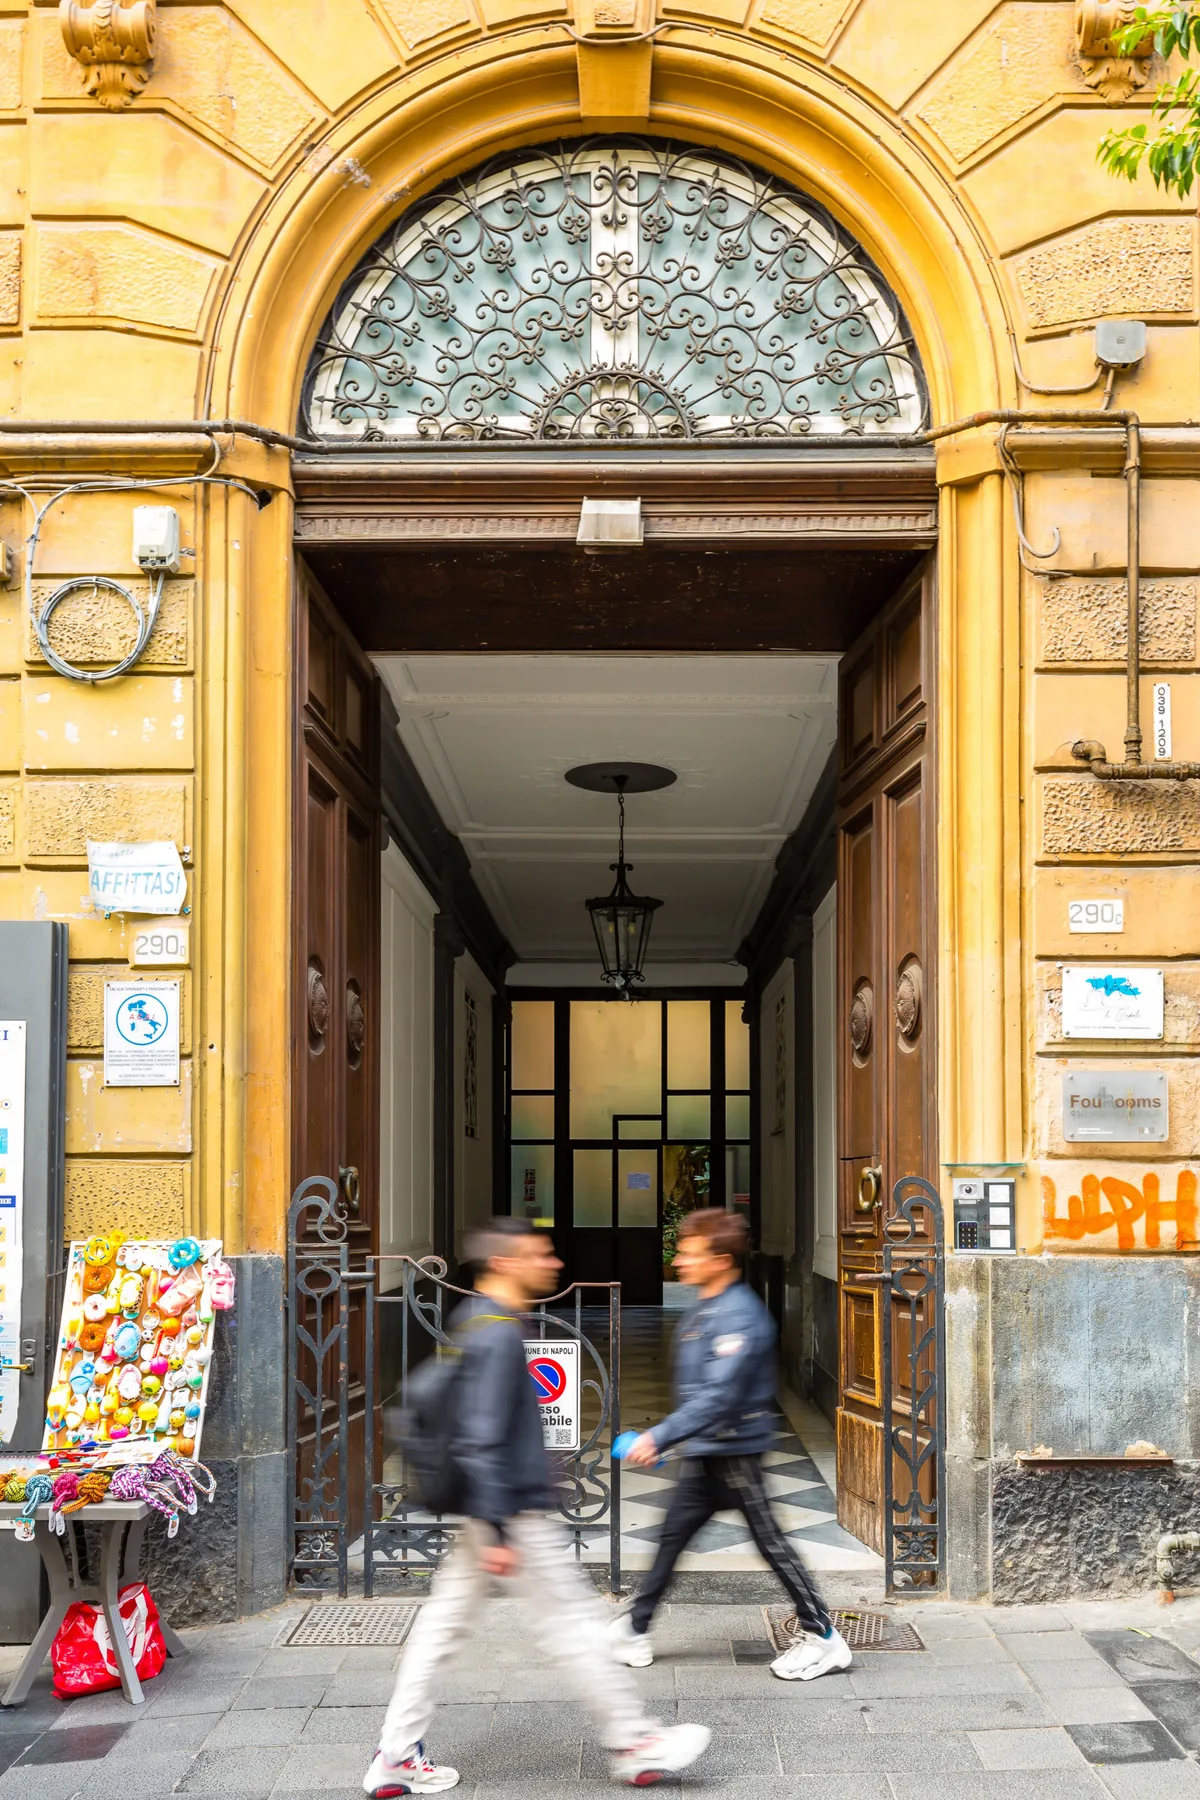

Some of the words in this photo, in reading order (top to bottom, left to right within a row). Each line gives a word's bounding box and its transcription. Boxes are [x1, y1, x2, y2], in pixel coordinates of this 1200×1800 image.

[91, 869, 181, 895] AFFITTASI
[542, 1347, 549, 1355] DI
[550, 1347, 574, 1355] NAPOLI
